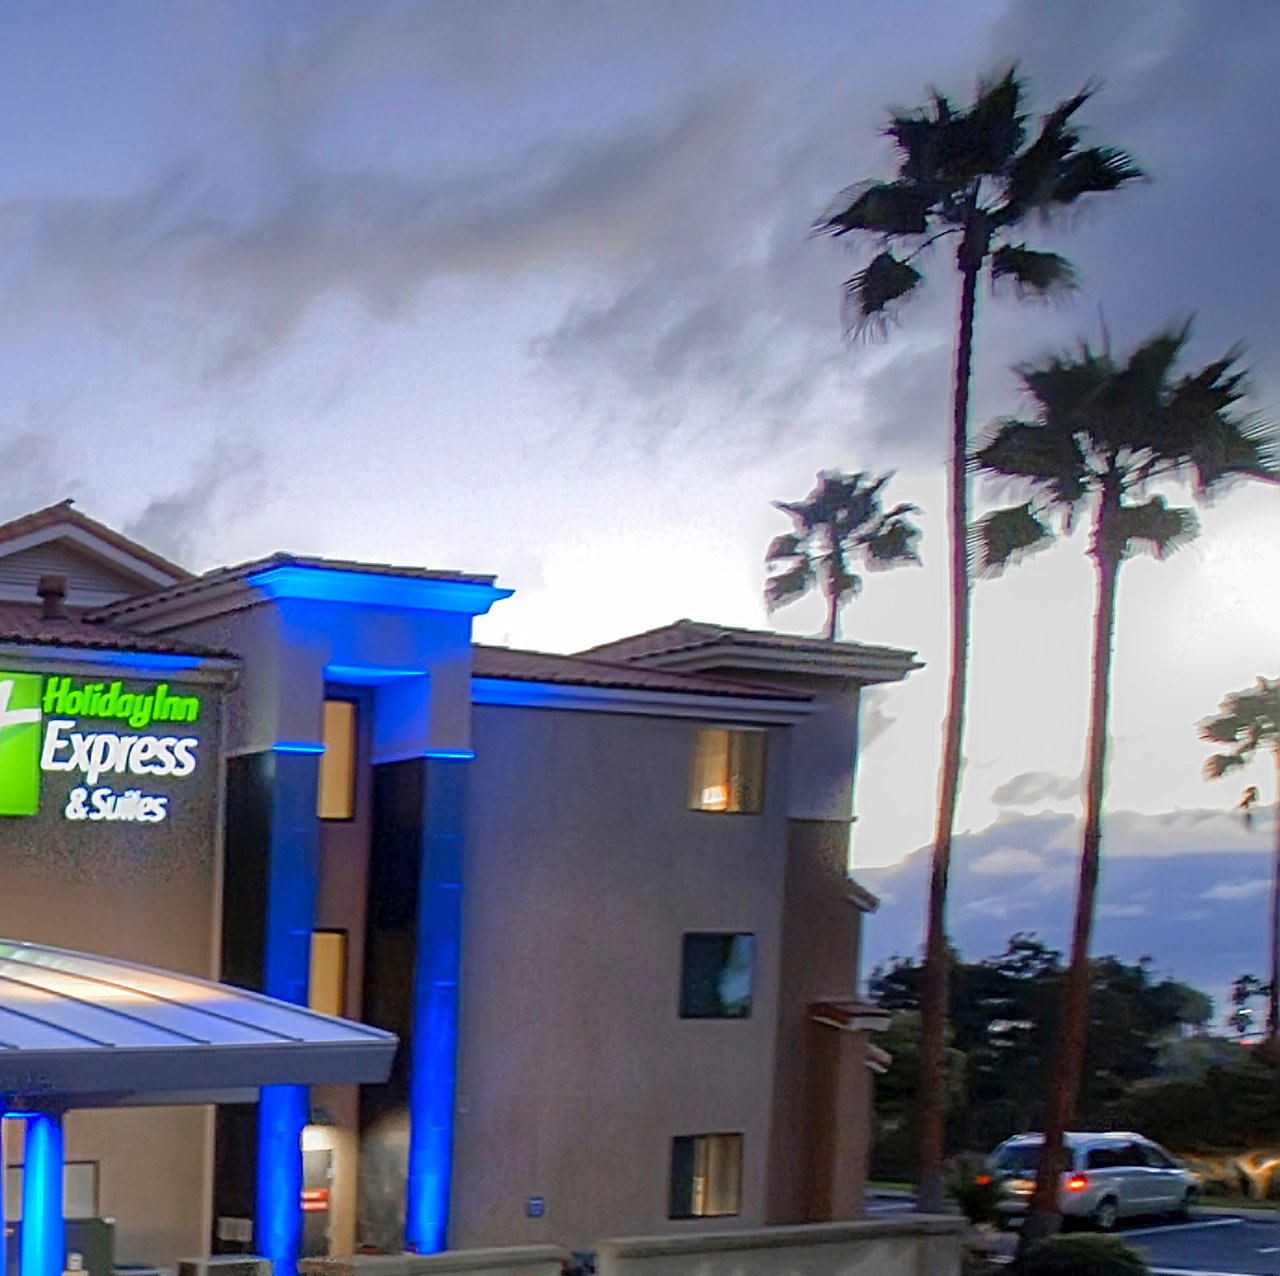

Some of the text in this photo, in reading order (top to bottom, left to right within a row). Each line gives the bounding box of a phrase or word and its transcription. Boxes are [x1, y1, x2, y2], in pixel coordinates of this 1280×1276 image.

[42, 676, 200, 728] Holiday Inn
[40, 719, 199, 785] Express
[65, 787, 168, 822] & Suites
